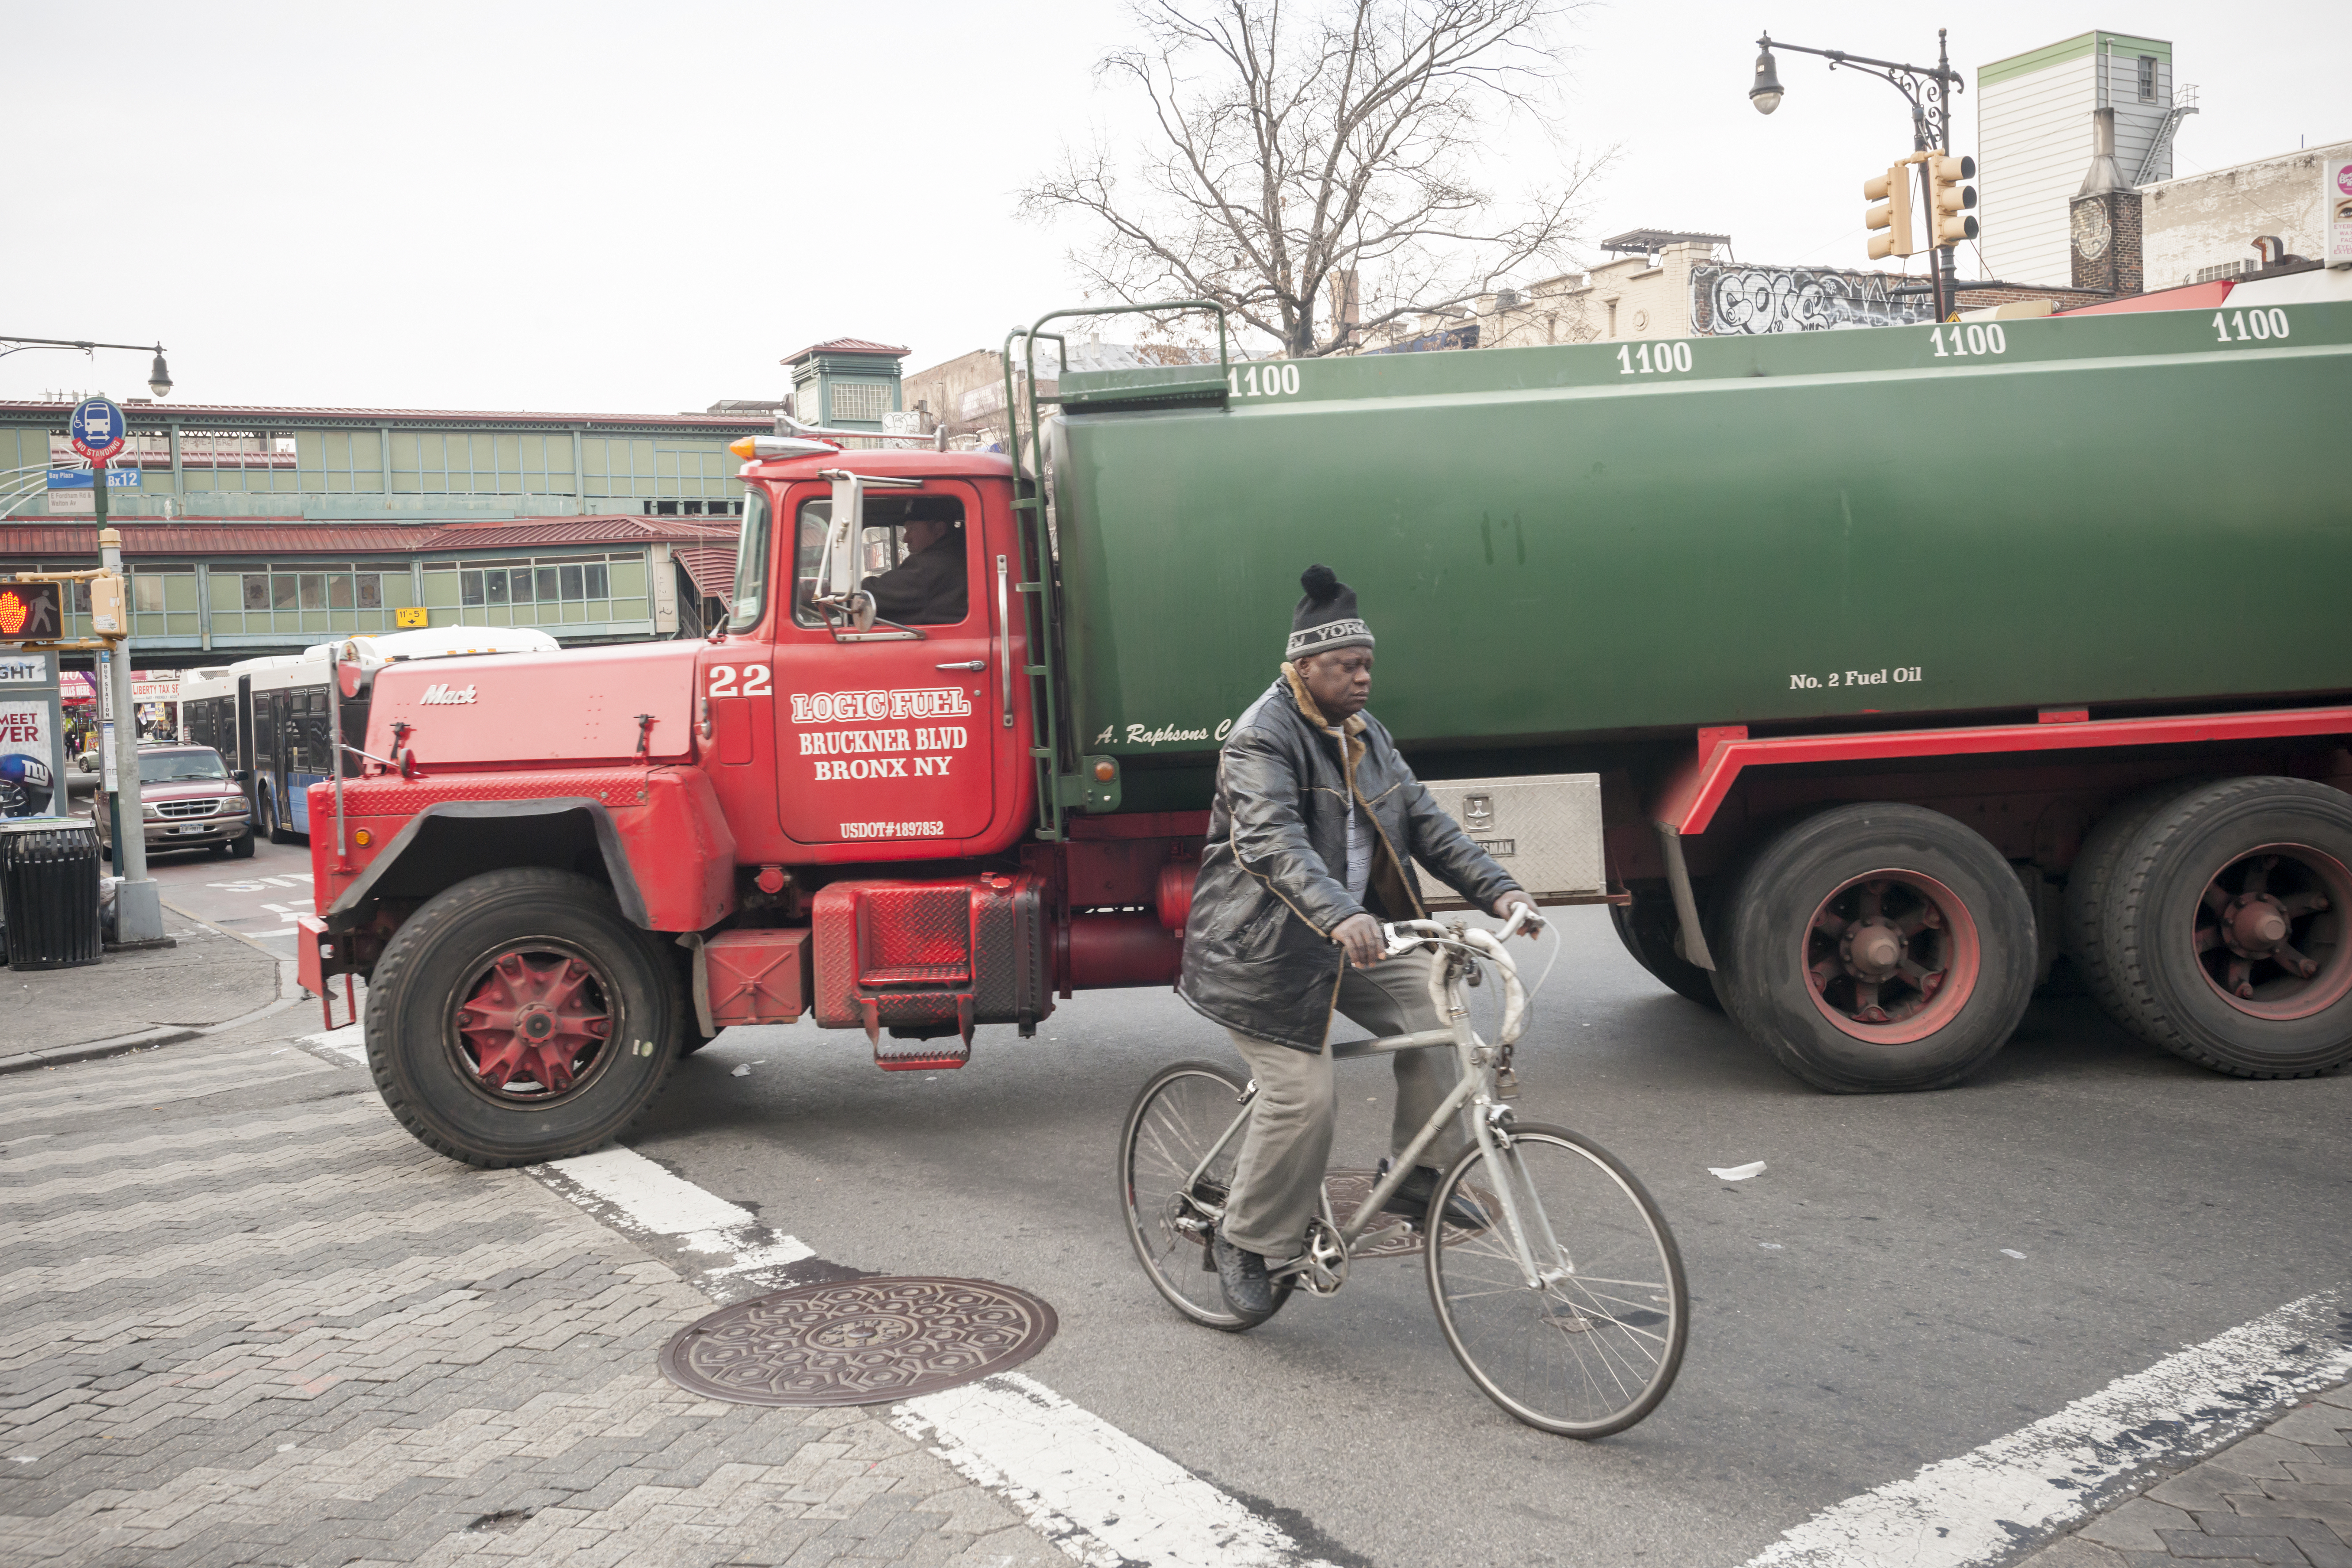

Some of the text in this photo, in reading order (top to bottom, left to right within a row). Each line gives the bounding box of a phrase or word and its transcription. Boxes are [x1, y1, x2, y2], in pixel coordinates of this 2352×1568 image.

[2212, 308, 2290, 342] 1100
[1929, 323, 2006, 357] 1100
[1616, 341, 1693, 375] 1100
[1228, 364, 1300, 397] 1100
[76, 440, 120, 457] NO STANDING
[108, 473, 137, 486] Bx12
[1317, 623, 1370, 640] YORK
[0, 666, 35, 679] GHT
[709, 664, 772, 697] 22
[1789, 667, 1922, 689] No. 2 Fuel Oil
[61, 685, 90, 696] BILLS HERE
[133, 685, 157, 695] LIBERTY
[159, 685, 170, 693] TAX
[419, 684, 477, 705] Mack
[791, 686, 971, 723] LOGIC FUEL
[0, 713, 38, 725] MEET
[799, 727, 967, 755] BRUCKNER BLVD
[1094, 725, 1118, 746] A.
[1126, 723, 1209, 747] Raphsons
[814, 756, 953, 780] BRONX NY
[840, 821, 944, 838] USDOT#1897852
